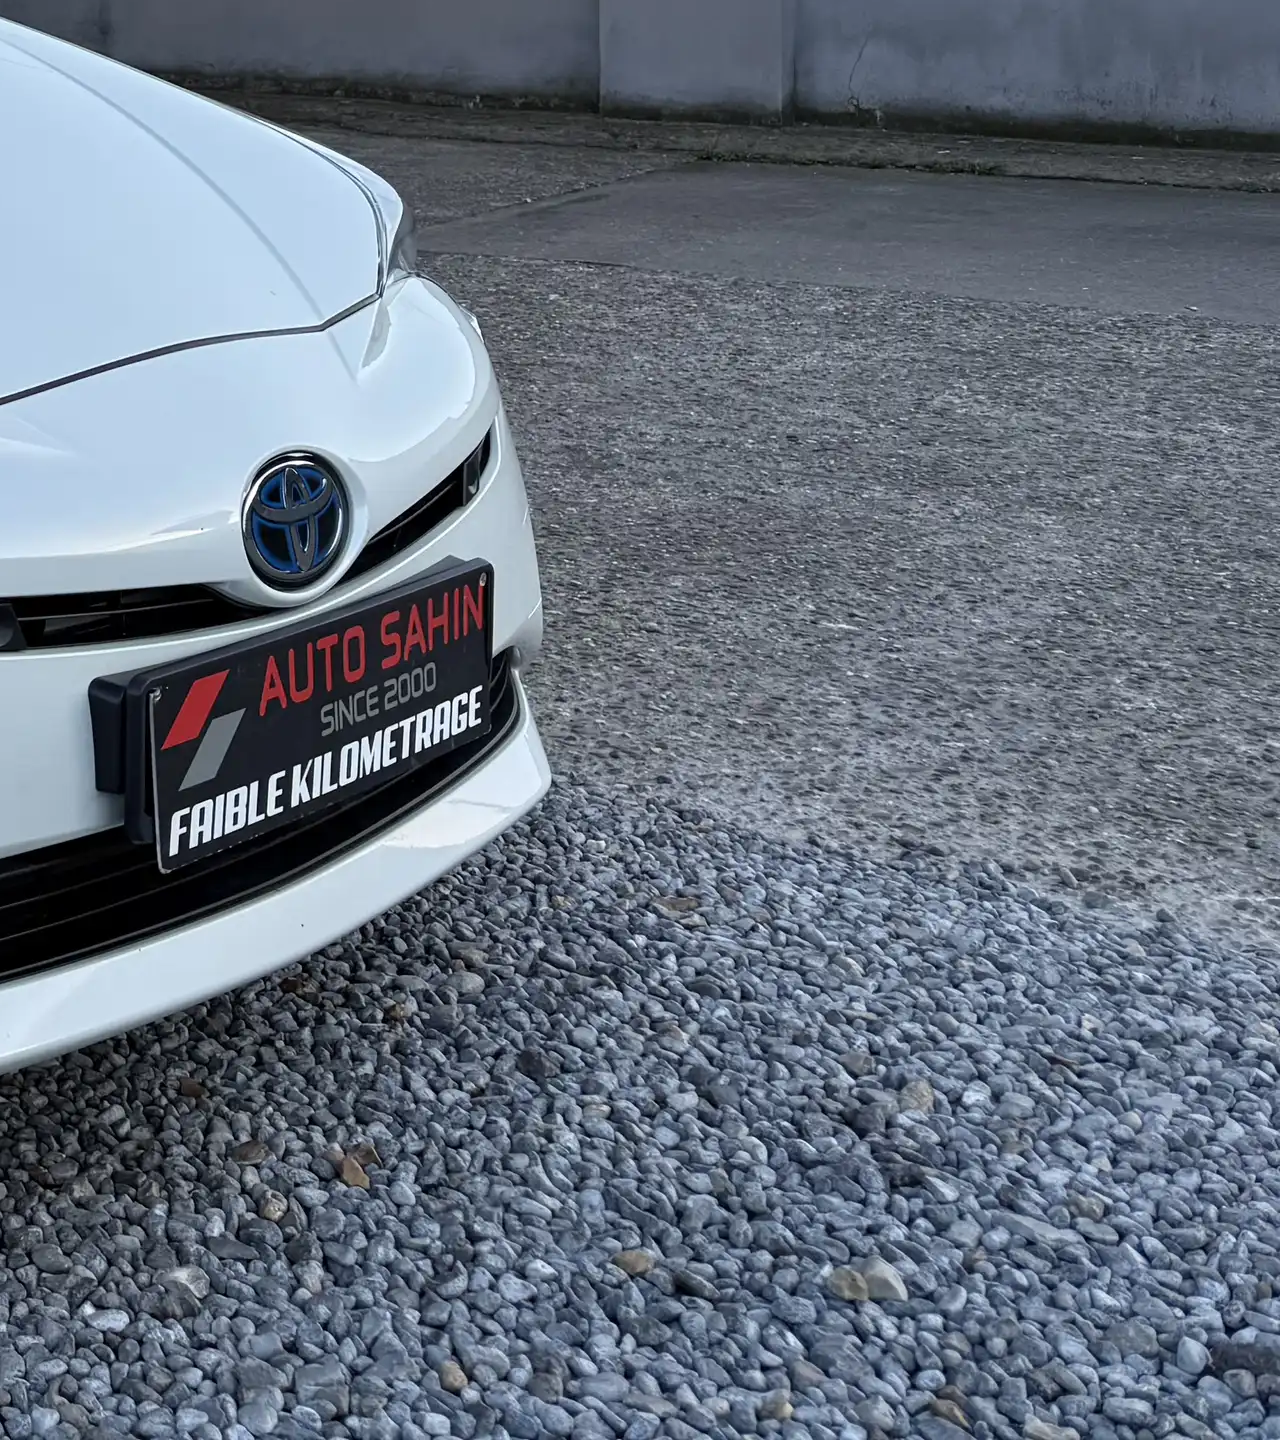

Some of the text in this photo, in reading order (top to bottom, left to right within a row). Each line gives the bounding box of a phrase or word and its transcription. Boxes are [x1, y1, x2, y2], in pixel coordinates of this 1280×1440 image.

[258, 583, 485, 717] AUTO SAHIN
[320, 661, 437, 738] SINCE 2000
[168, 685, 484, 858] FAIBLE KILOMETRAGE
